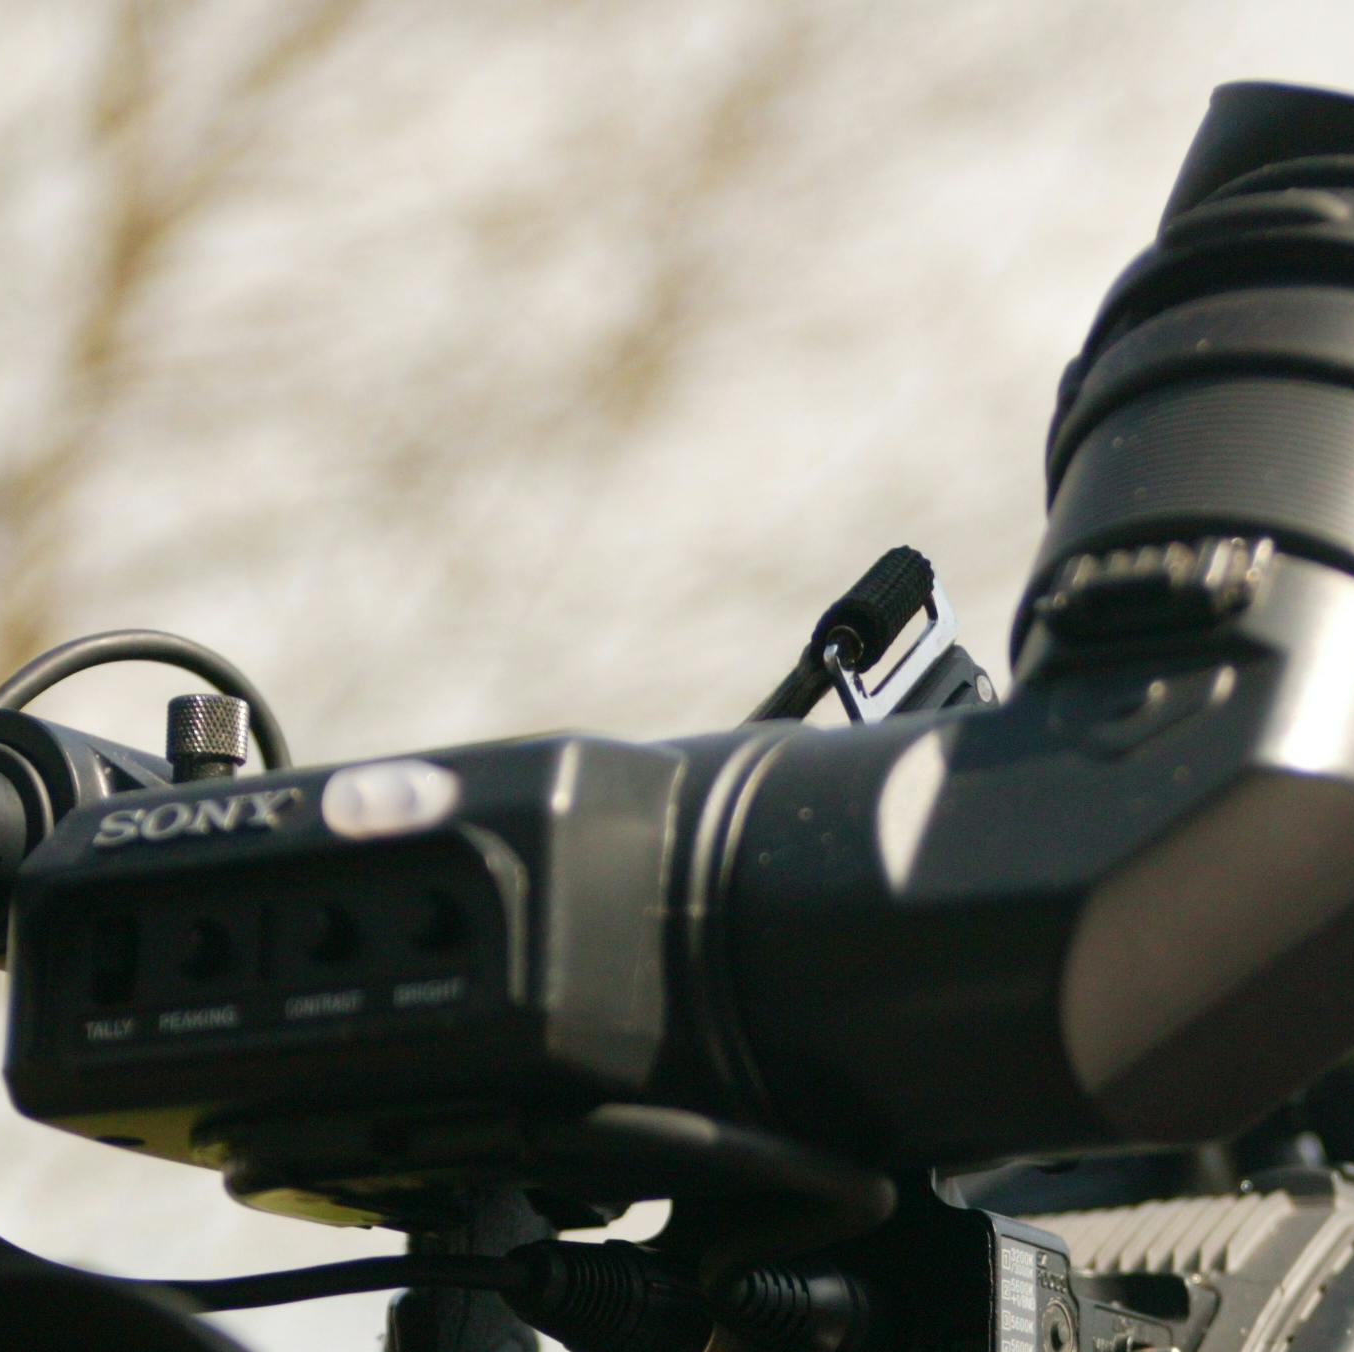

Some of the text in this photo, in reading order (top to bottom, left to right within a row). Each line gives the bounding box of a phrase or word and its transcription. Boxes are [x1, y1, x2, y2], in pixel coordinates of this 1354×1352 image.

[92, 787, 301, 845] SONY
[85, 1017, 134, 1041] TALLY
[158, 1004, 239, 1034] PEAKING
